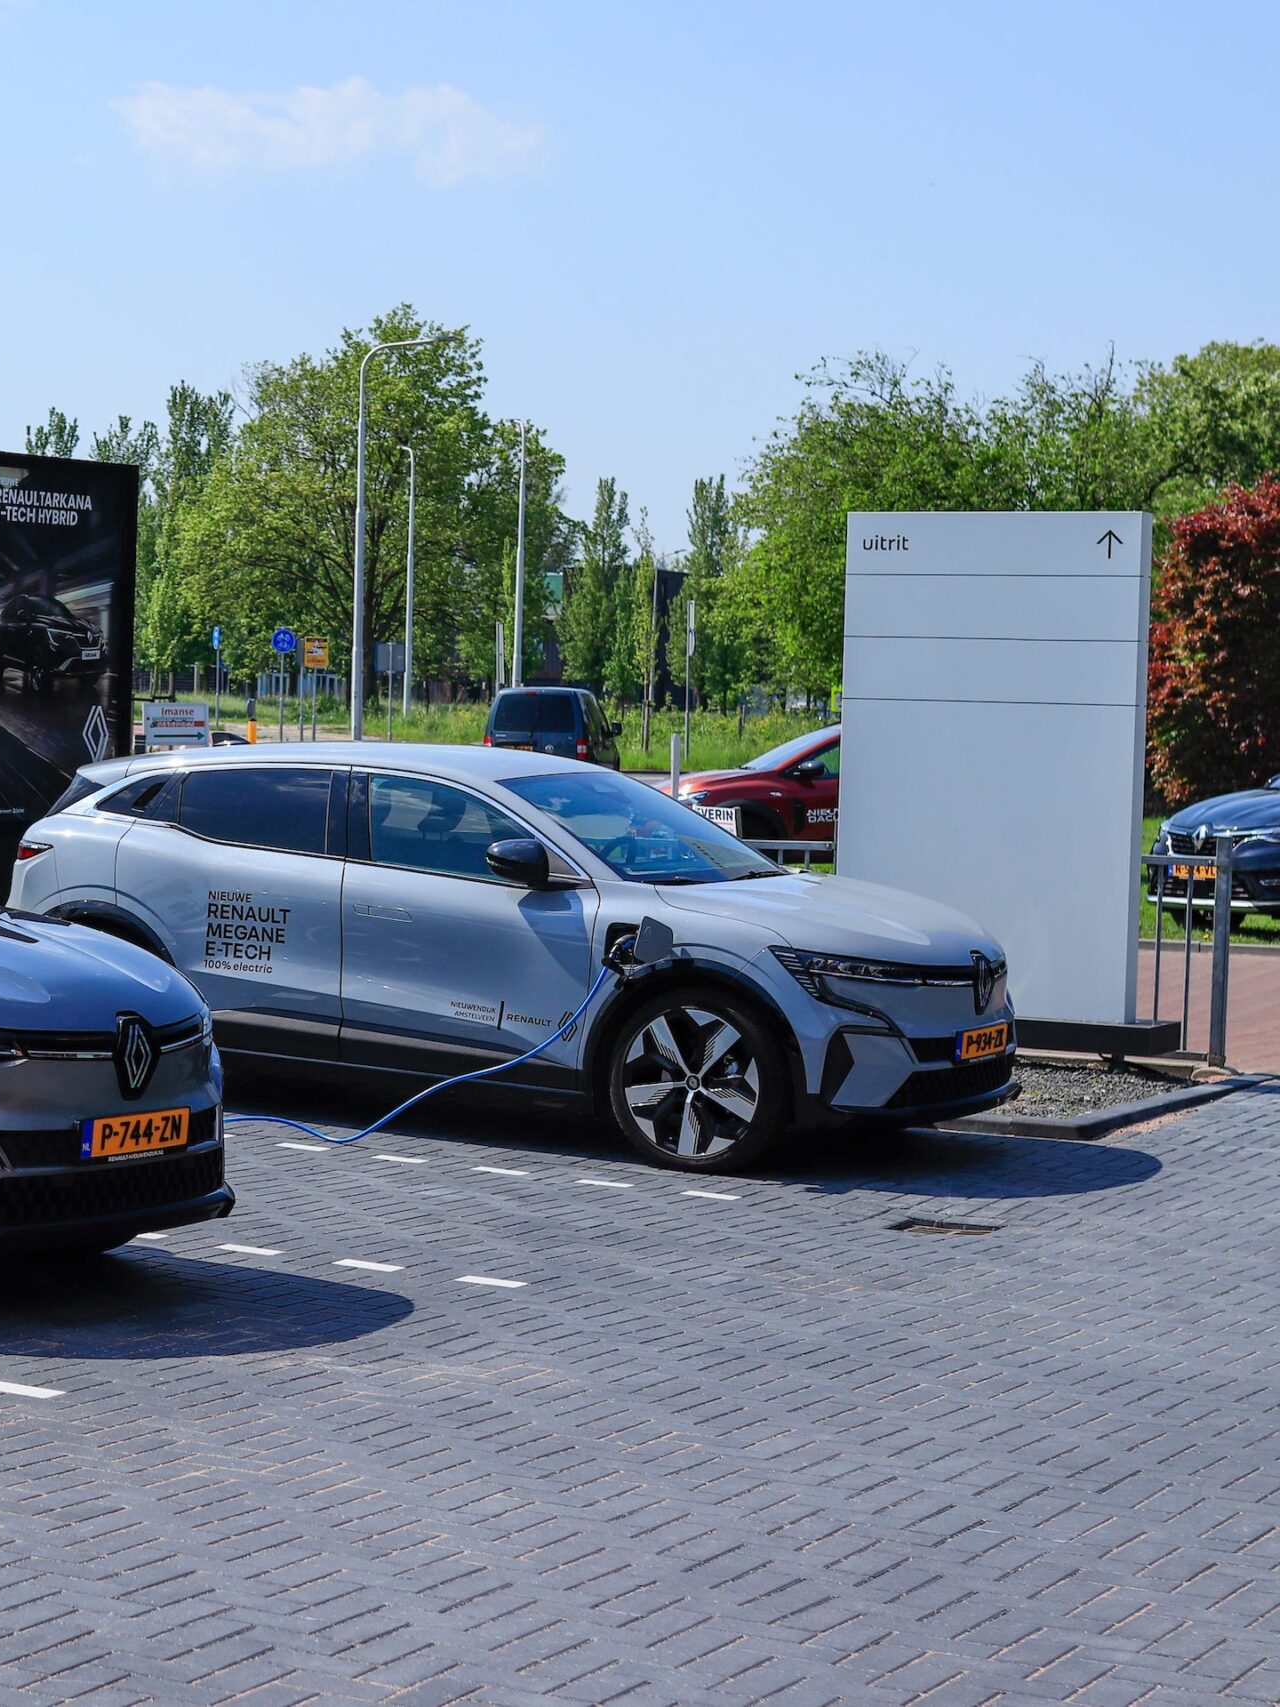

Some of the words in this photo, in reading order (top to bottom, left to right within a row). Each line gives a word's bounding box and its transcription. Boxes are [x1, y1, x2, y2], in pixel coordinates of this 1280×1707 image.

[38, 508, 78, 526] HYBRID
[863, 534, 909, 551] uitrit
[161, 707, 195, 716] Imanse
[807, 808, 838, 817] NIEU
[208, 890, 252, 903] NIEUWE
[207, 903, 291, 924] RENAULT
[206, 922, 286, 944] MEGANE
[205, 941, 272, 961] E-TECH
[204, 959, 231, 970] 100%
[233, 961, 273, 973] electric
[450, 1001, 496, 1014] NIEUWENDIJK
[454, 1010, 495, 1022] AMSTELVEEN
[506, 1013, 552, 1027] RENAULT
[101, 1114, 183, 1151] P-744-ZN
[82, 1143, 91, 1152] NL
